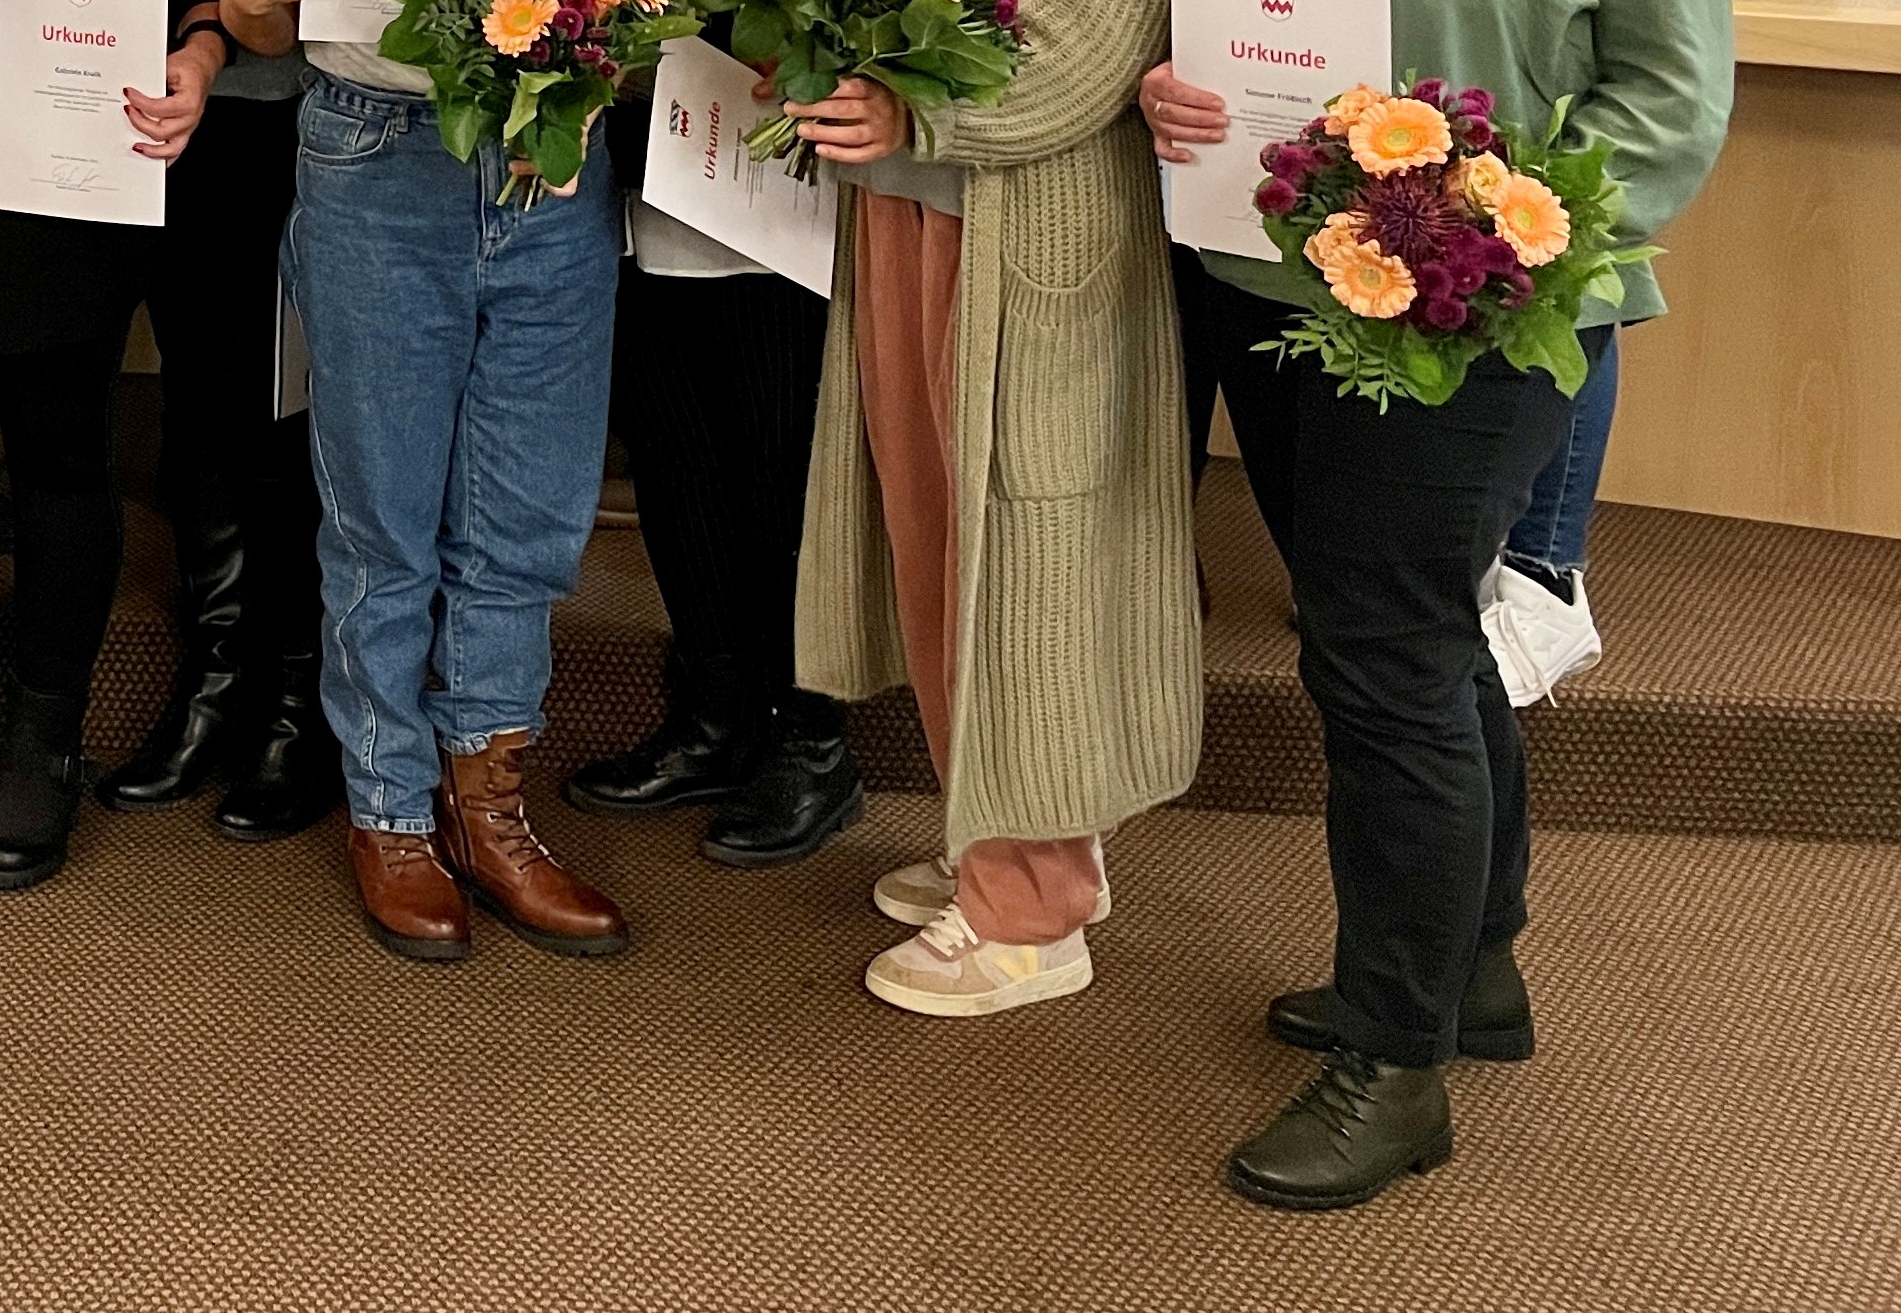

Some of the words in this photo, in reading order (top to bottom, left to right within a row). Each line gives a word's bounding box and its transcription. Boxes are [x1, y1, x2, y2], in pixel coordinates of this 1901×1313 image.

[42, 24, 117, 48] Urkunde
[1230, 39, 1327, 70] Urkunde
[703, 101, 722, 180] Urkunde
